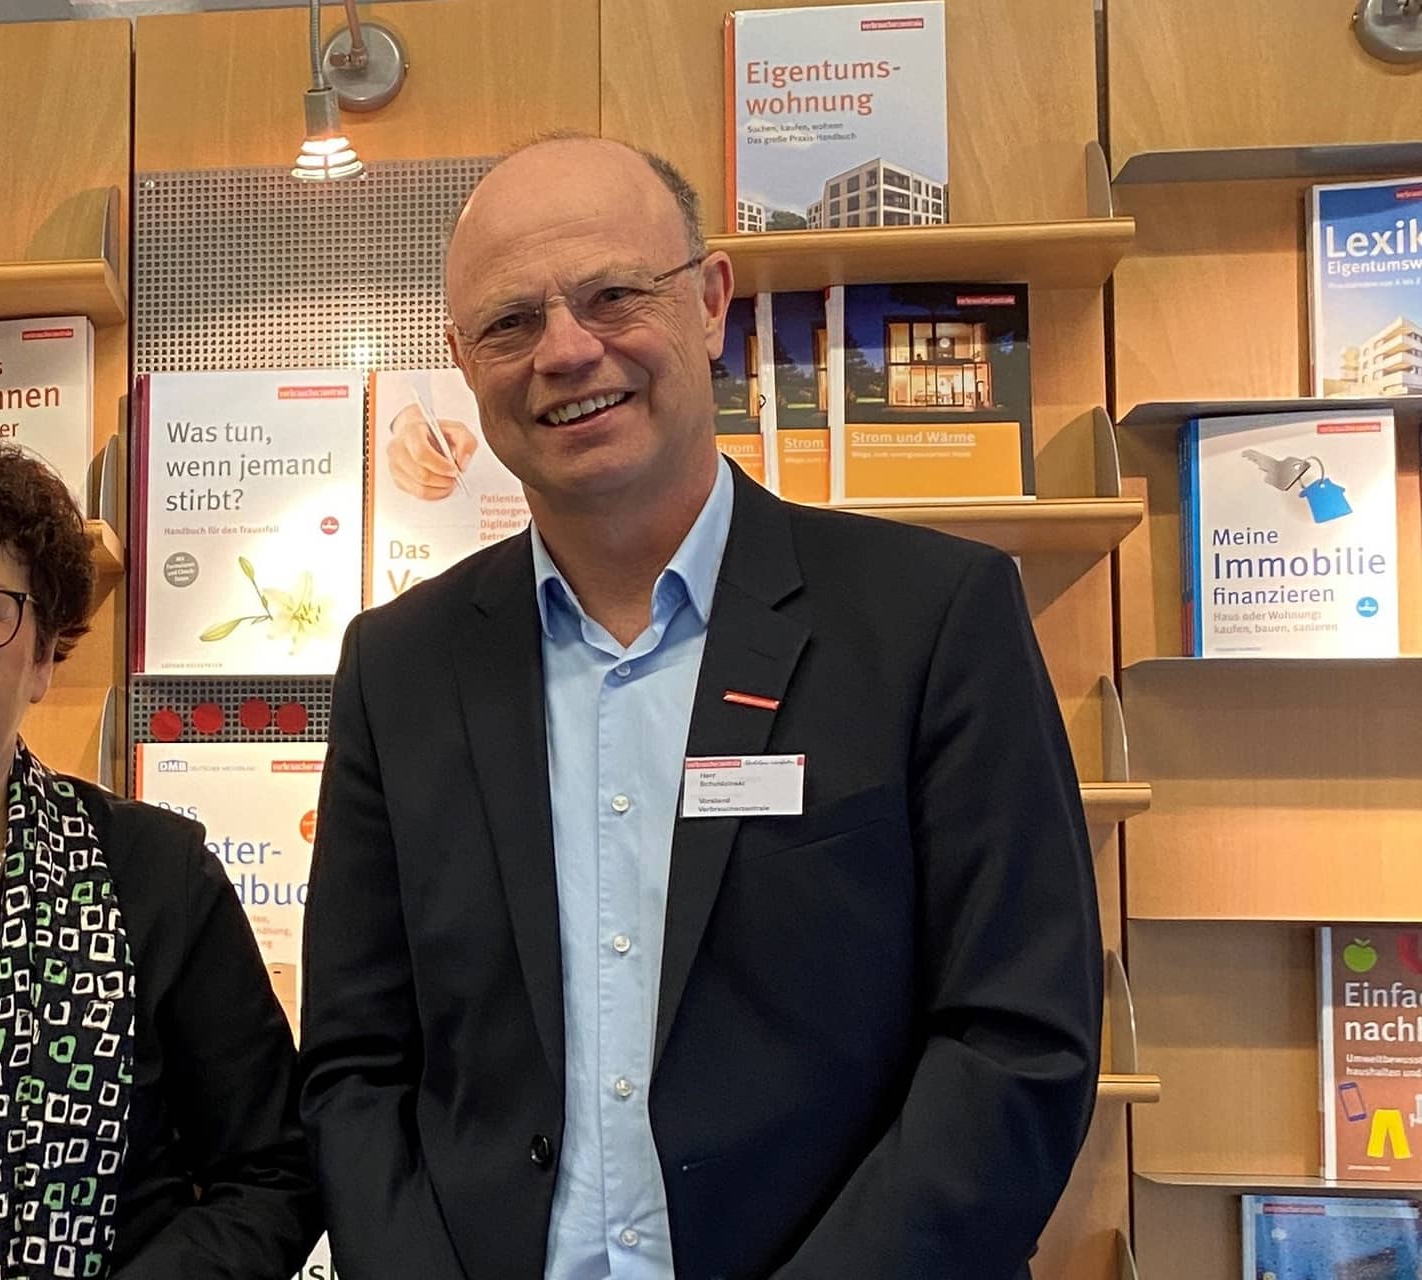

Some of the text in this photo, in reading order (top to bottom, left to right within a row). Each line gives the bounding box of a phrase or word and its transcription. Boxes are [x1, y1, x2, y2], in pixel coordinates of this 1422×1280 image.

[747, 60, 901, 88] Eigentums-
[746, 91, 874, 115] wohnung
[747, 136, 762, 145] Das
[166, 422, 273, 446] Was tun,
[784, 437, 825, 450] Strom
[851, 430, 976, 444] Strom und Wärme
[166, 451, 333, 482] wenn jemand
[165, 488, 245, 512] stirbt?
[164, 526, 206, 536] Handbuch
[221, 525, 237, 535] den
[1212, 527, 1279, 546] Meine
[389, 541, 431, 560] Das
[1214, 547, 1386, 579] Immobilie
[1213, 585, 1335, 606] finanzieren
[1214, 612, 1239, 622] Haus
[1242, 610, 1266, 621] oder
[1214, 622, 1338, 634] kaufen, bauen, sanieren
[160, 761, 187, 772] DMB
[1345, 982, 1422, 1009] Einfa
